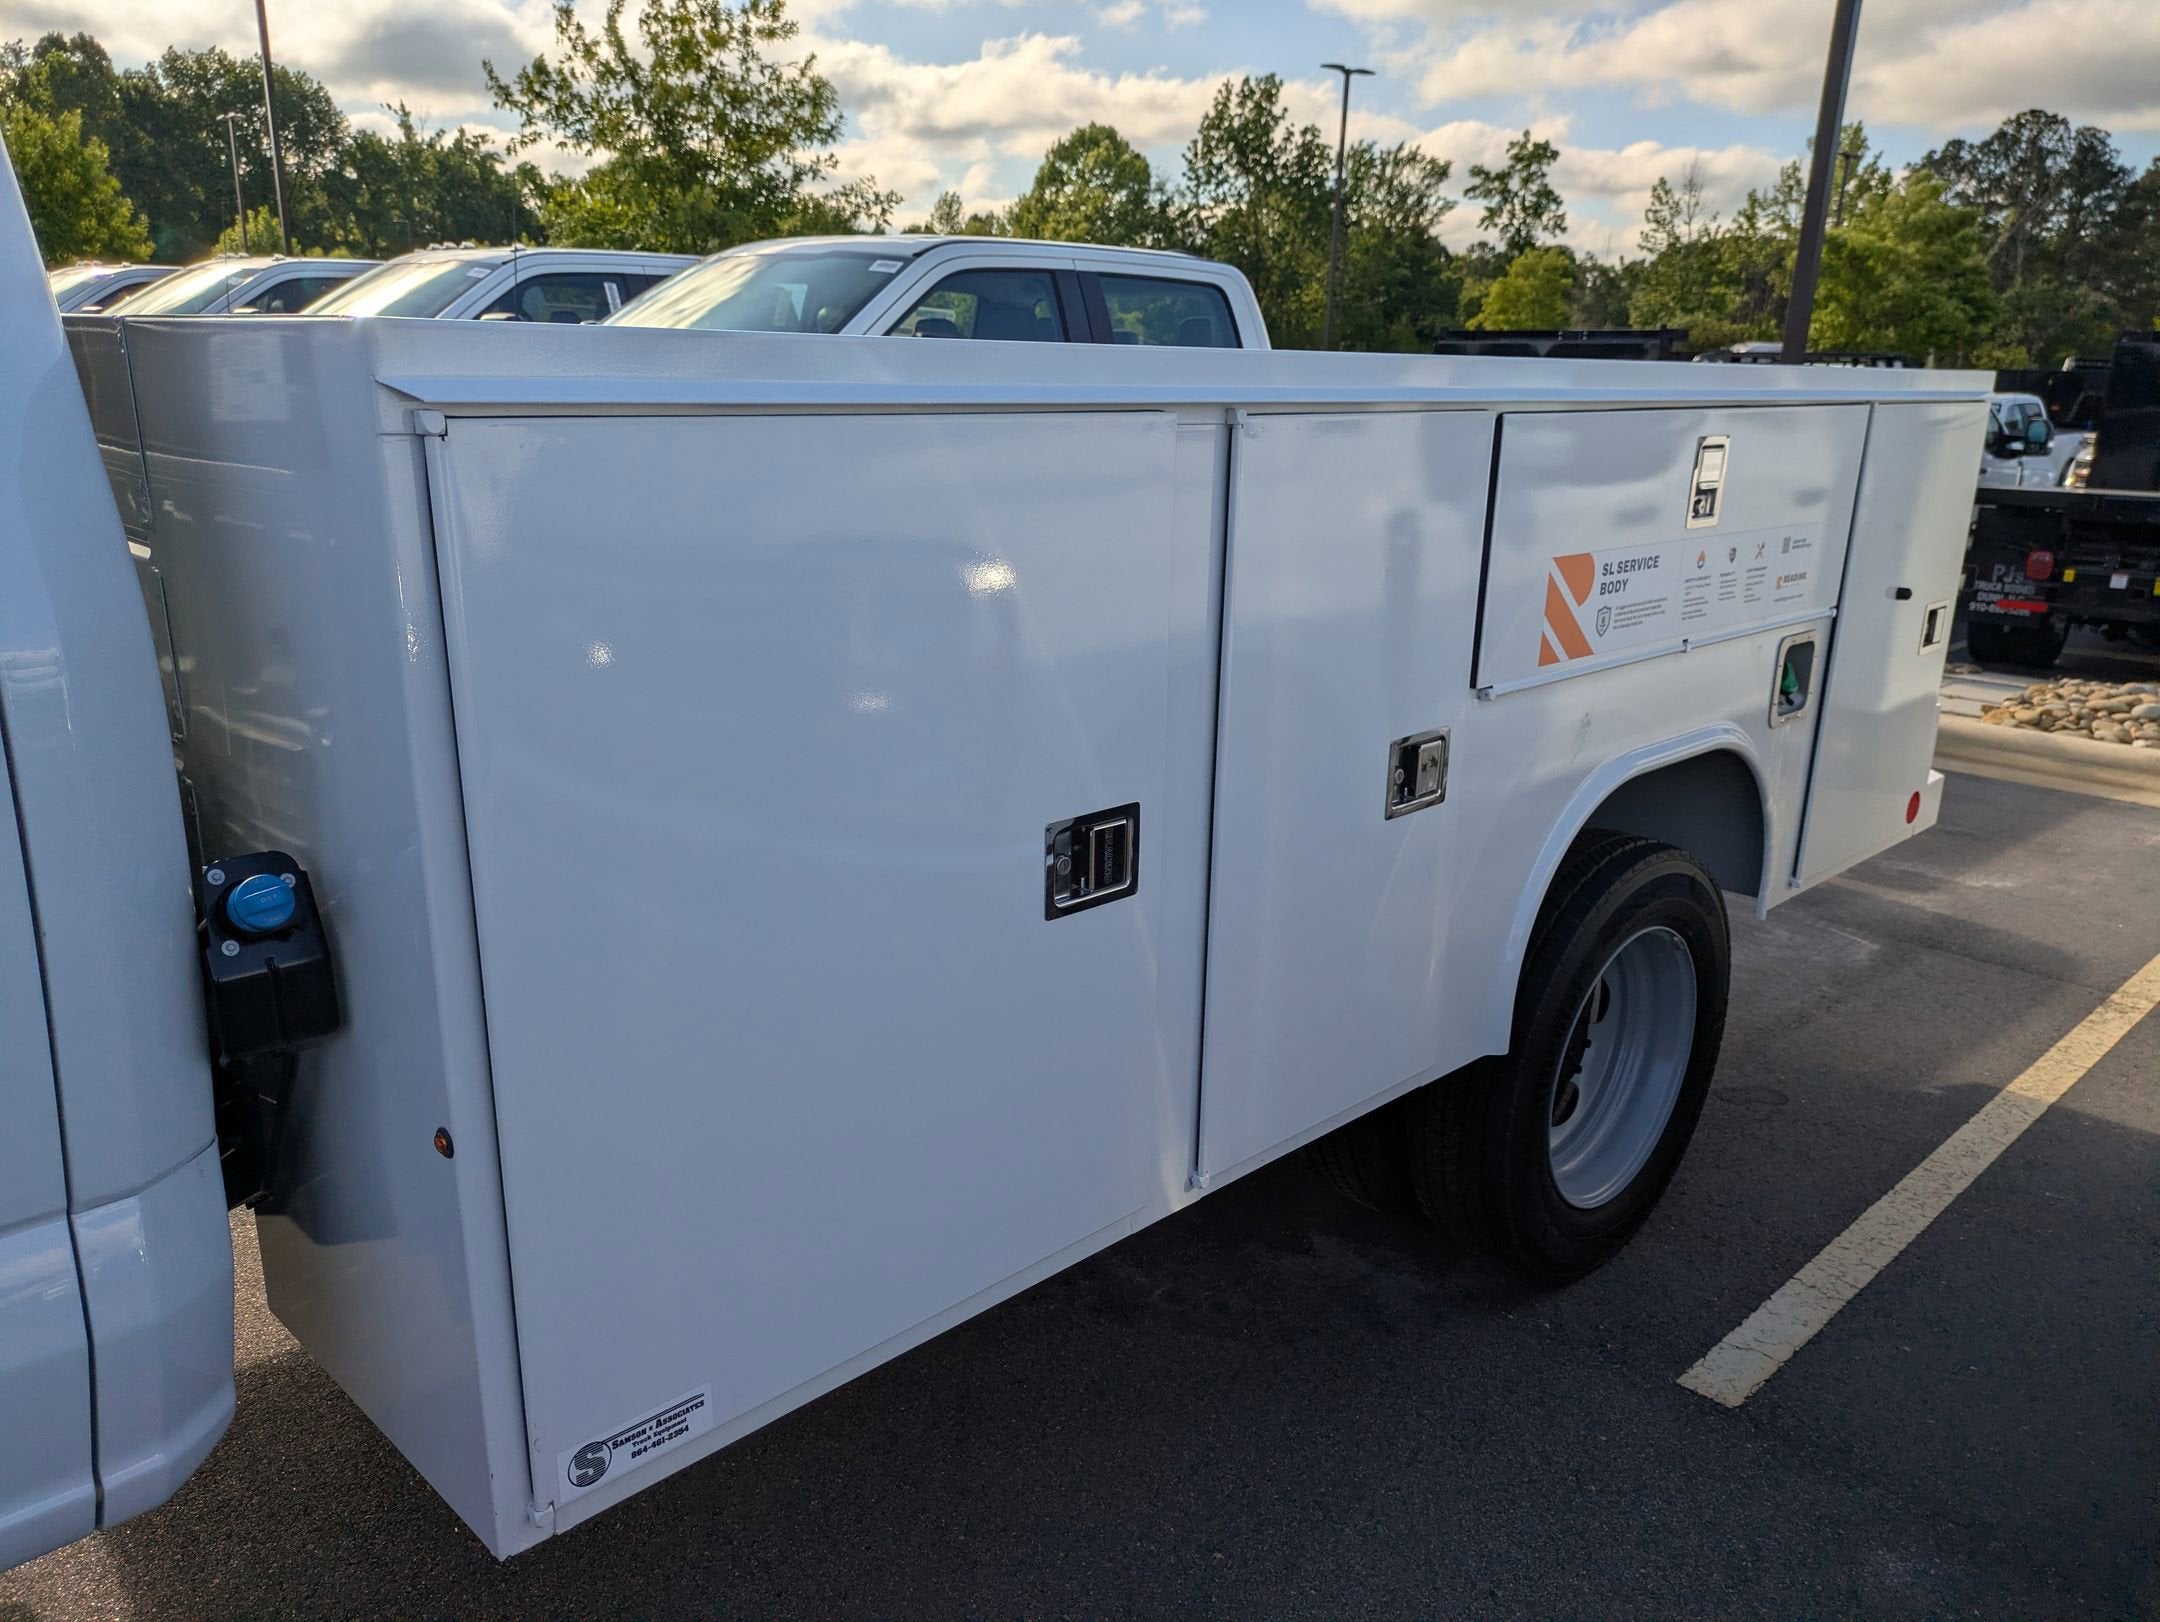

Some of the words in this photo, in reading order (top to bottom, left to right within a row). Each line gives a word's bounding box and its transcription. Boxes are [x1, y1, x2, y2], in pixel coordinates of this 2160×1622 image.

[1601, 562, 1615, 577] SL
[1616, 555, 1660, 575] SERVICE
[1599, 578, 1629, 596] BODY
[612, 1427, 647, 1450] SAMSON
[655, 1400, 705, 1429] ASSOCIATES
[632, 1435, 653, 1448] Truck
[653, 1417, 688, 1438] Equipment
